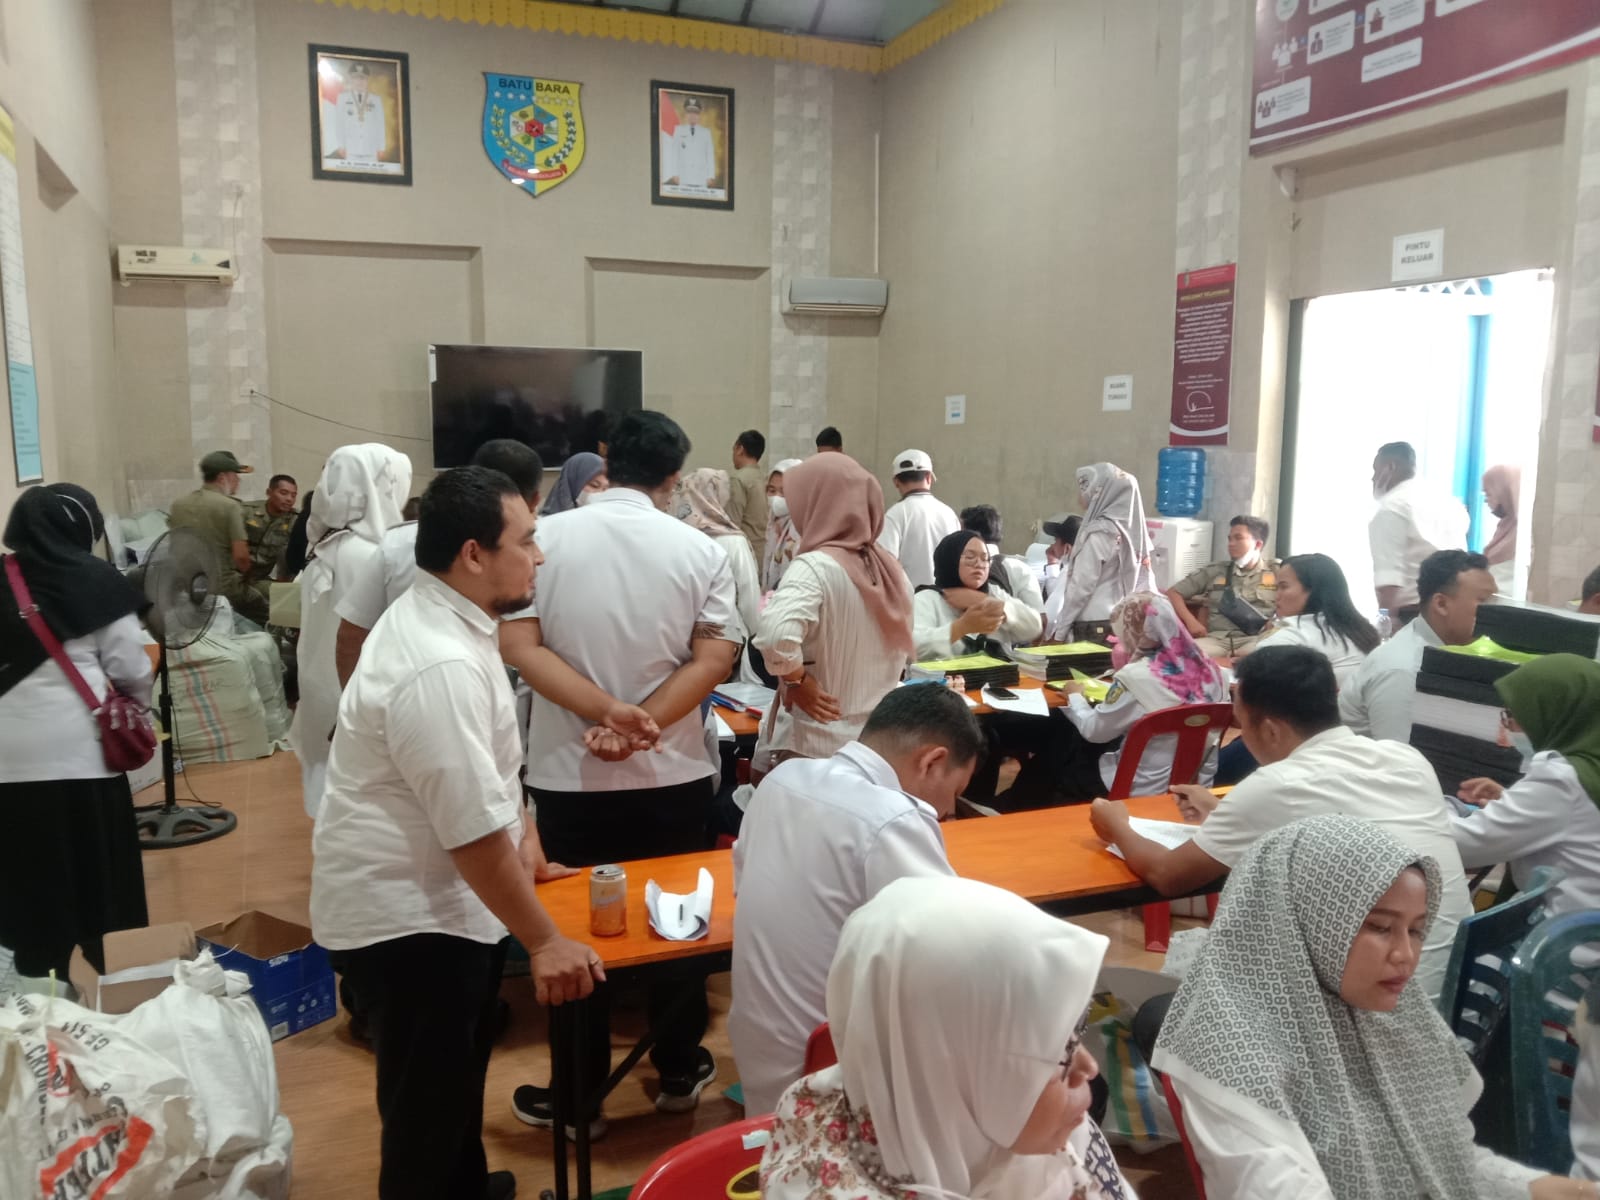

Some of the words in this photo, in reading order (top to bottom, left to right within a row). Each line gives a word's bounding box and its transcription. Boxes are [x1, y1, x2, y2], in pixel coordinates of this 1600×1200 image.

[498, 78, 532, 90] BATU
[535, 82, 571, 95] BARA
[1405, 240, 1431, 251] PINTU
[1400, 252, 1434, 264] KELUAR
